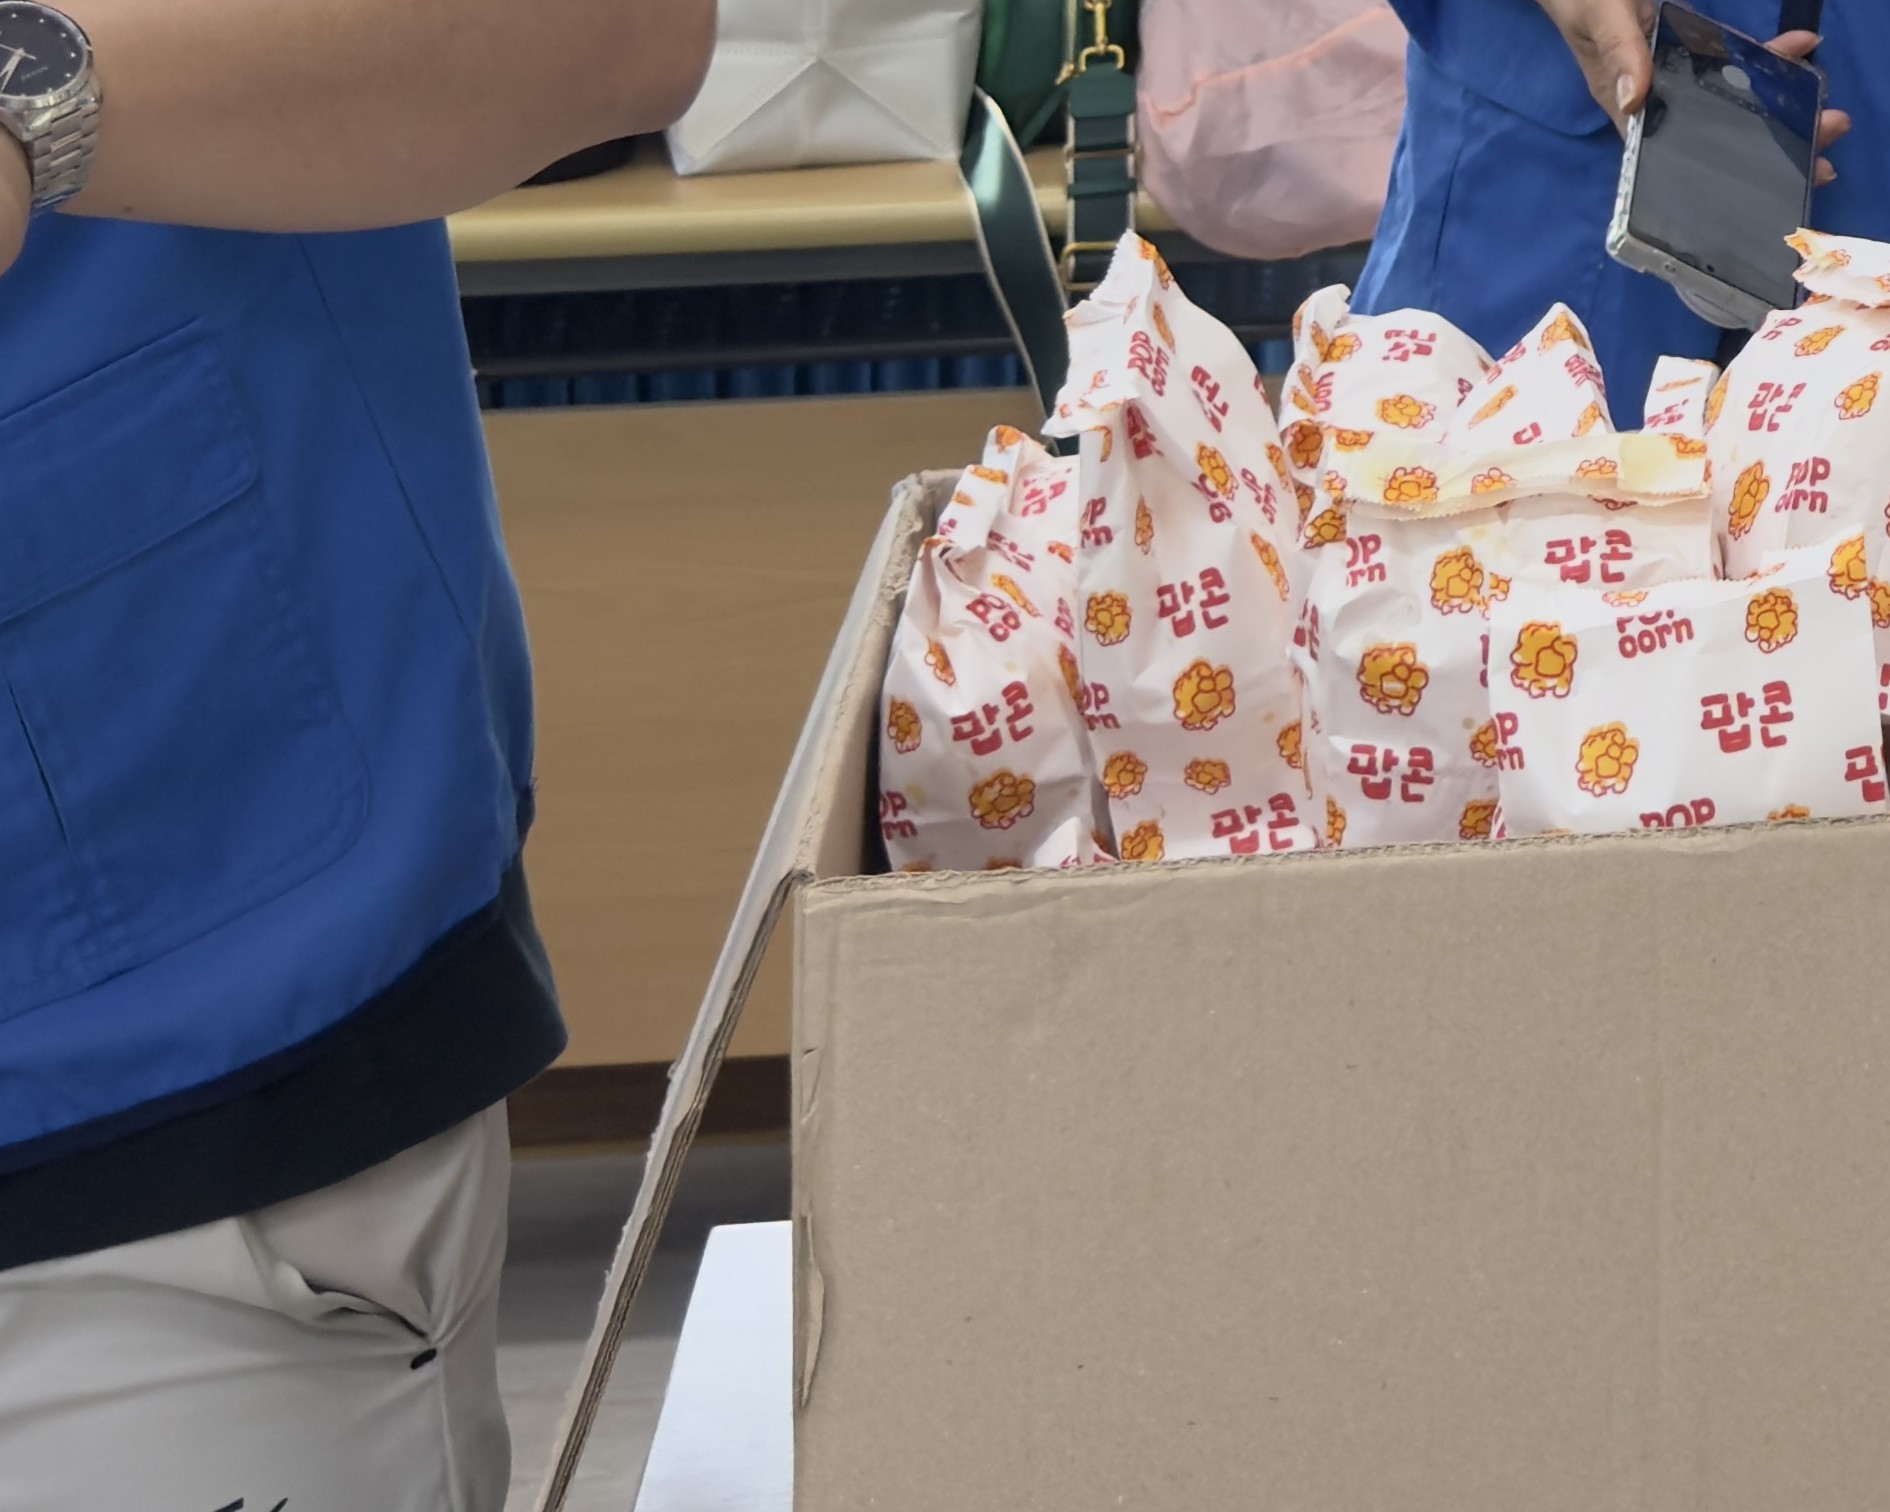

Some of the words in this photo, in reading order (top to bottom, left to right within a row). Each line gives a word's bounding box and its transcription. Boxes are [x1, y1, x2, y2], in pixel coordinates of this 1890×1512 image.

[1544, 529, 1633, 584] 팝콘
[1157, 567, 1231, 638] 팝콘
[1618, 616, 1694, 659] corn
[950, 680, 1034, 756] 팝콘
[1700, 679, 1794, 754] 팝콘
[1347, 743, 1435, 803] 팝콘
[1211, 792, 1300, 855] 팝콘
